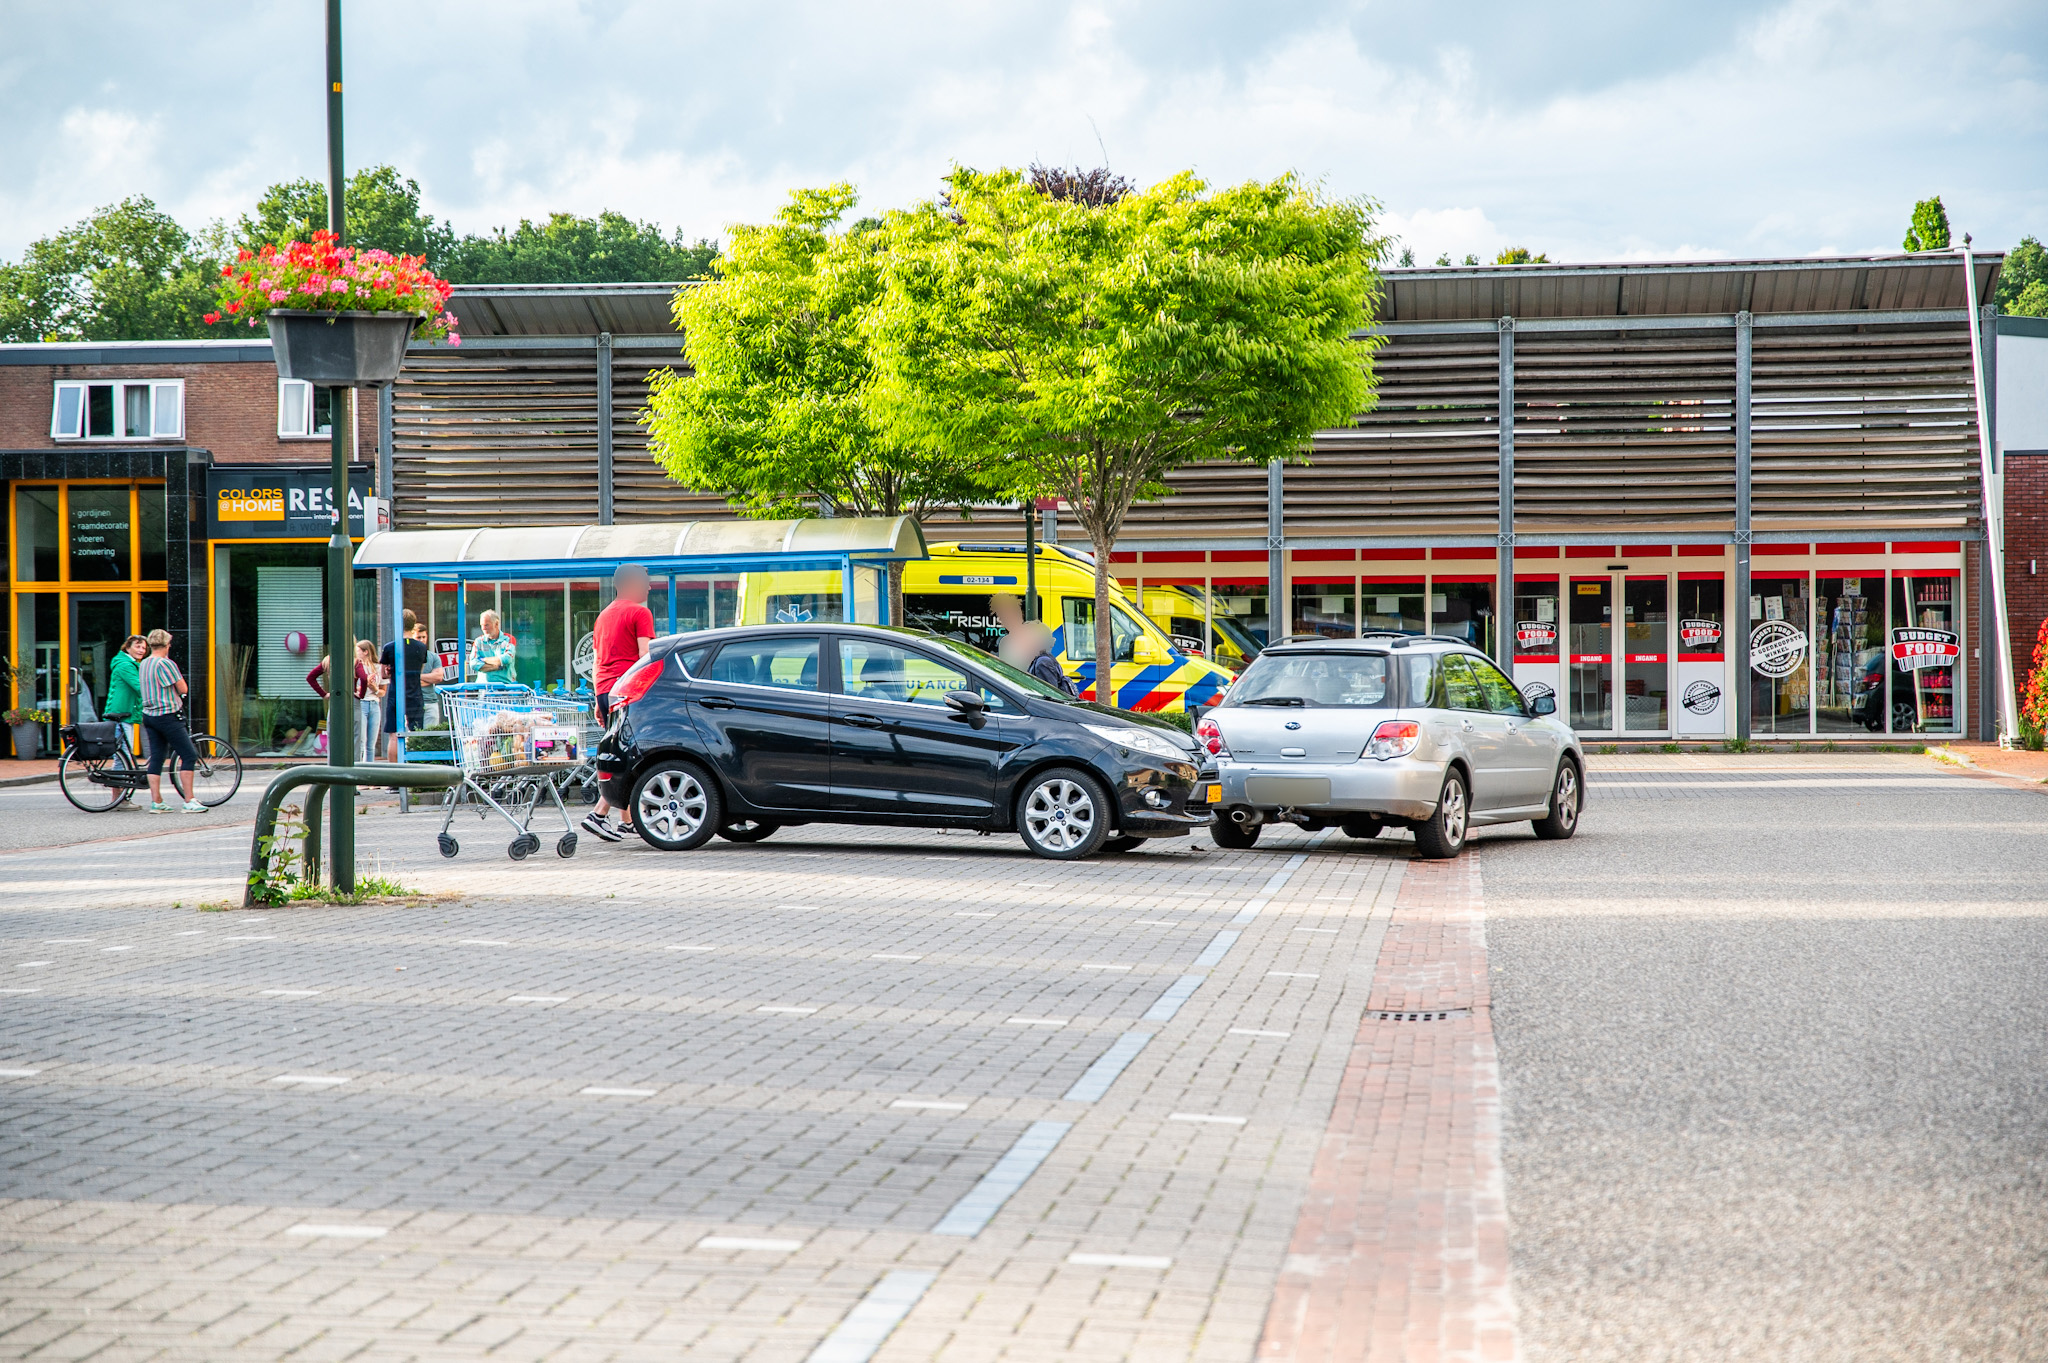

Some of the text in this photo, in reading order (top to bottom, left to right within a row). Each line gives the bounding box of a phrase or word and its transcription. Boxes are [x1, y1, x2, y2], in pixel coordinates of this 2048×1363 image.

[218, 488, 284, 500] COLORS
[232, 500, 283, 512] HOME
[77, 509, 111, 518] gordijnen
[77, 522, 129, 530] raamdecoratie
[77, 535, 105, 543] vloeren
[78, 548, 116, 557] zonwering
[1521, 623, 1552, 631] BUDGET
[1685, 621, 1717, 629] BUDGET
[1524, 630, 1549, 638] FOOD
[1689, 629, 1714, 637] FOOD
[1752, 625, 1792, 647] BUDGET FOOD
[1899, 631, 1951, 643] BUDGET
[1757, 633, 1803, 655] GOEDKOOPSTE
[1764, 646, 1790, 659] WINKEL
[1904, 643, 1946, 656] FOOD
